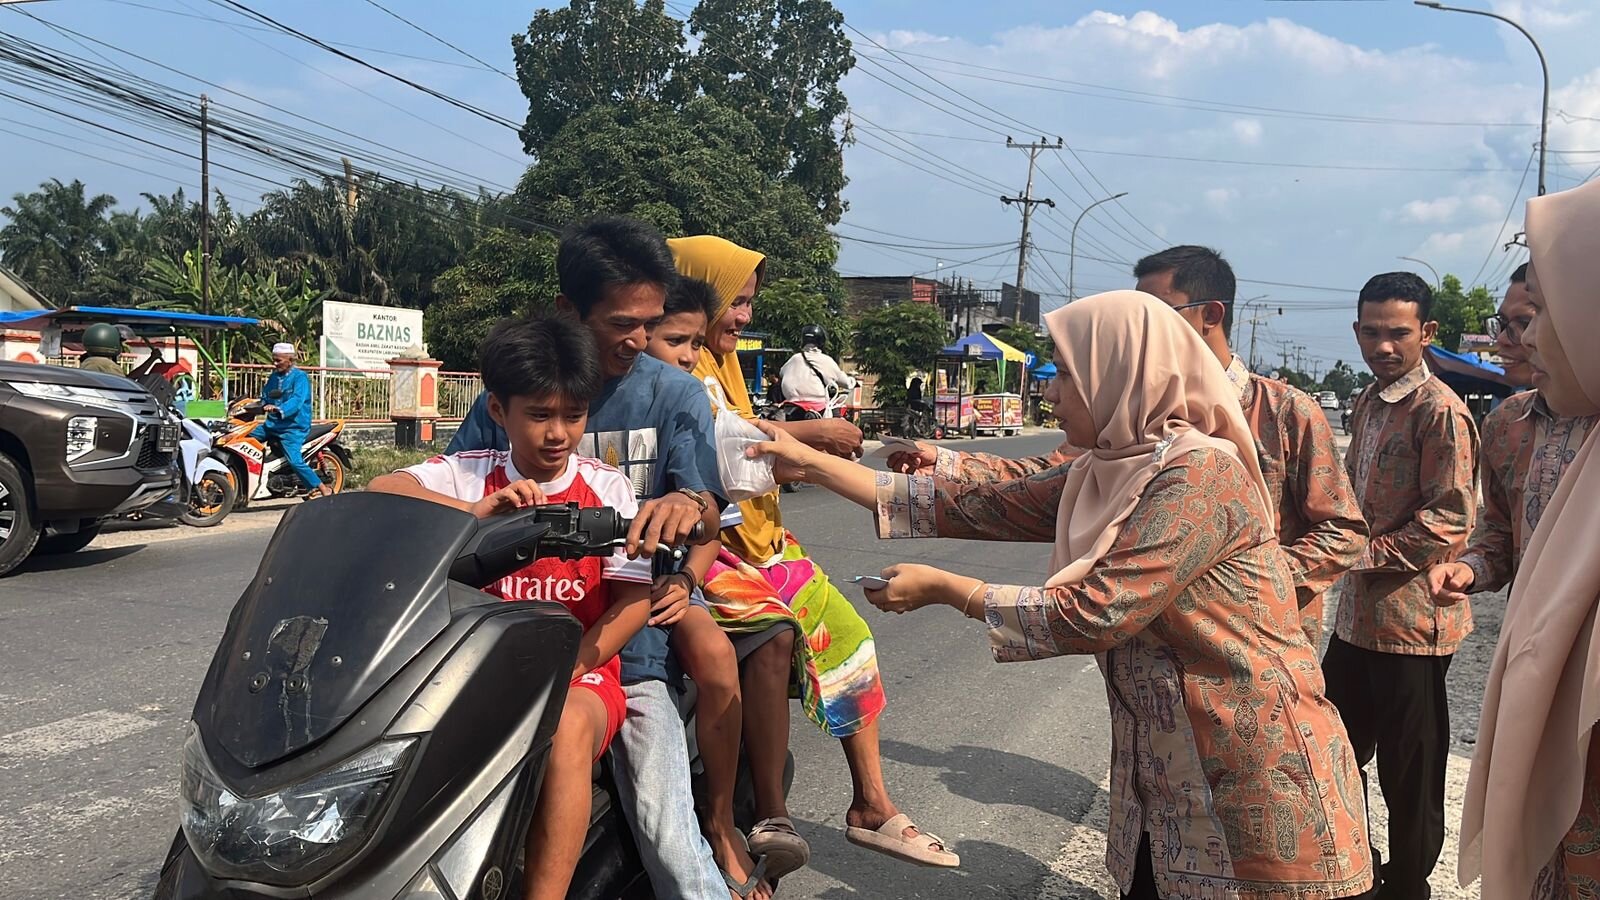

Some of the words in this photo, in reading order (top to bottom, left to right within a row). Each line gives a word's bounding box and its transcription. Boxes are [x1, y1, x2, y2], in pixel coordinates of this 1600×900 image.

[373, 313, 397, 322] KANTOR
[357, 322, 411, 343] BAZNAS
[239, 444, 263, 461] REP
